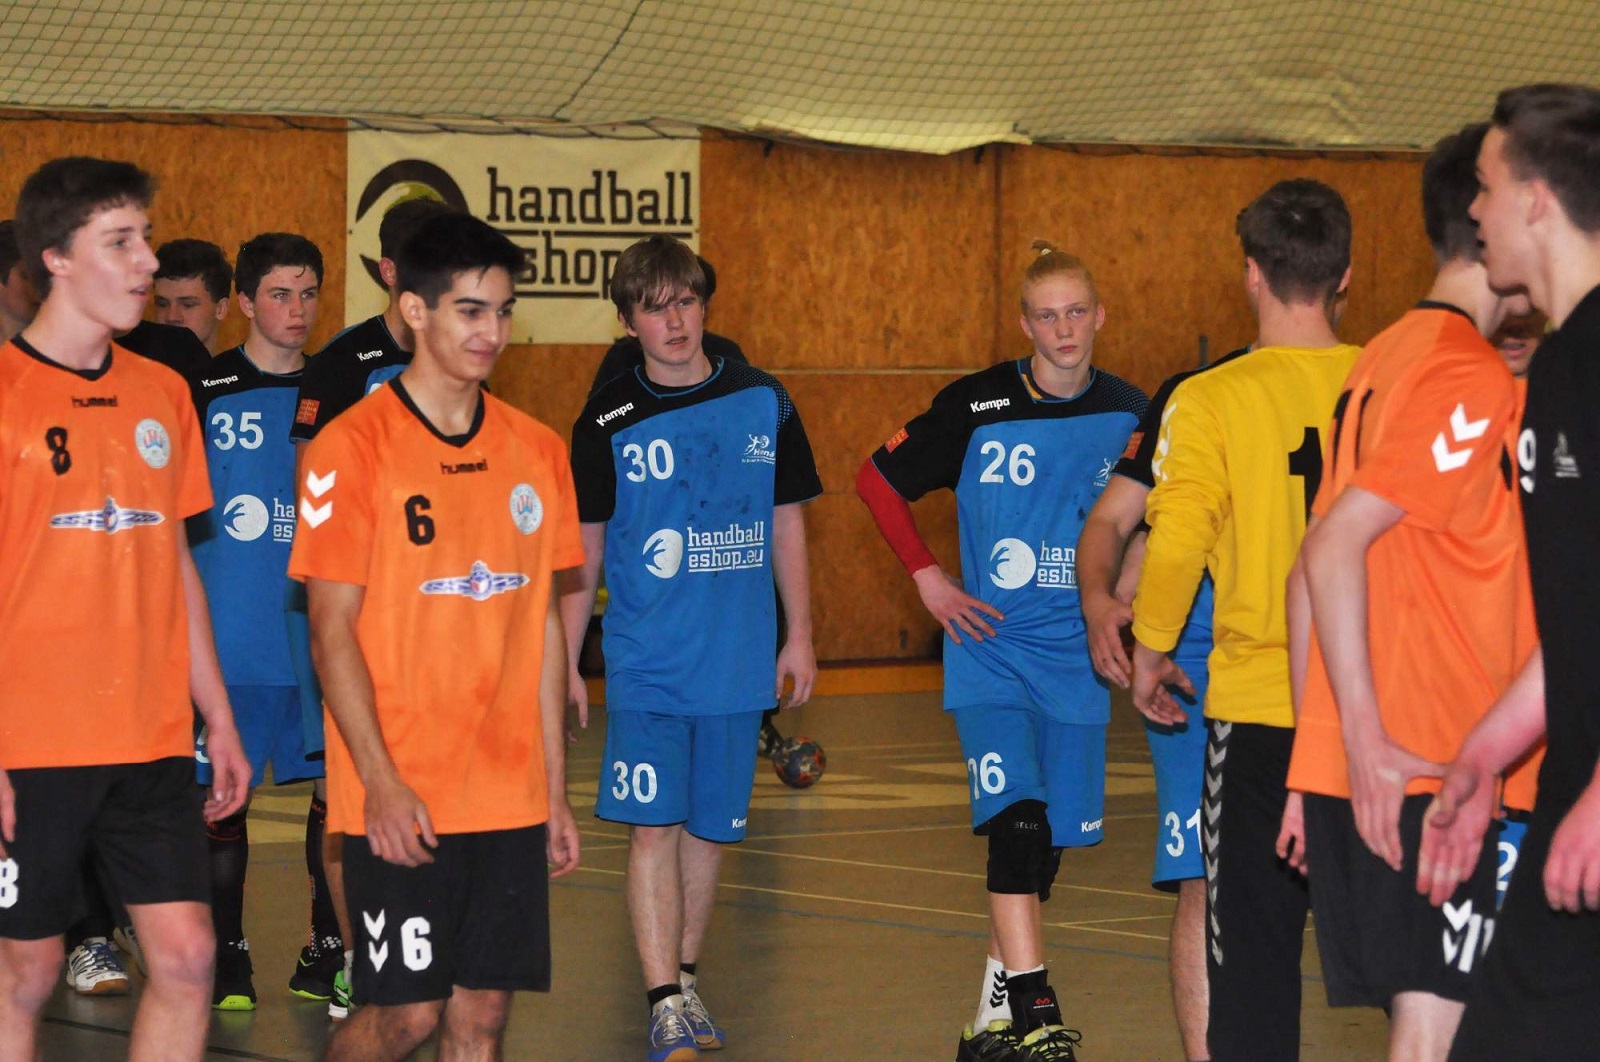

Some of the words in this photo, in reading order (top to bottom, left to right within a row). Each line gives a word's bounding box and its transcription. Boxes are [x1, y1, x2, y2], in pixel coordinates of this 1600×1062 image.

[486, 166, 693, 226] handball
[514, 230, 622, 300] shop
[202, 374, 239, 388] Kempa
[596, 402, 634, 427] Kempa
[970, 397, 1010, 413] Kempa
[45, 426, 71, 476] 8
[211, 412, 264, 451] 35
[622, 438, 675, 483] 30
[979, 440, 1036, 486] 26
[404, 494, 435, 546] 6
[687, 520, 764, 547] handball
[688, 548, 764, 571] eshop.eu
[1039, 540, 1076, 562] han
[612, 761, 658, 803] 30
[401, 916, 433, 972] 6
